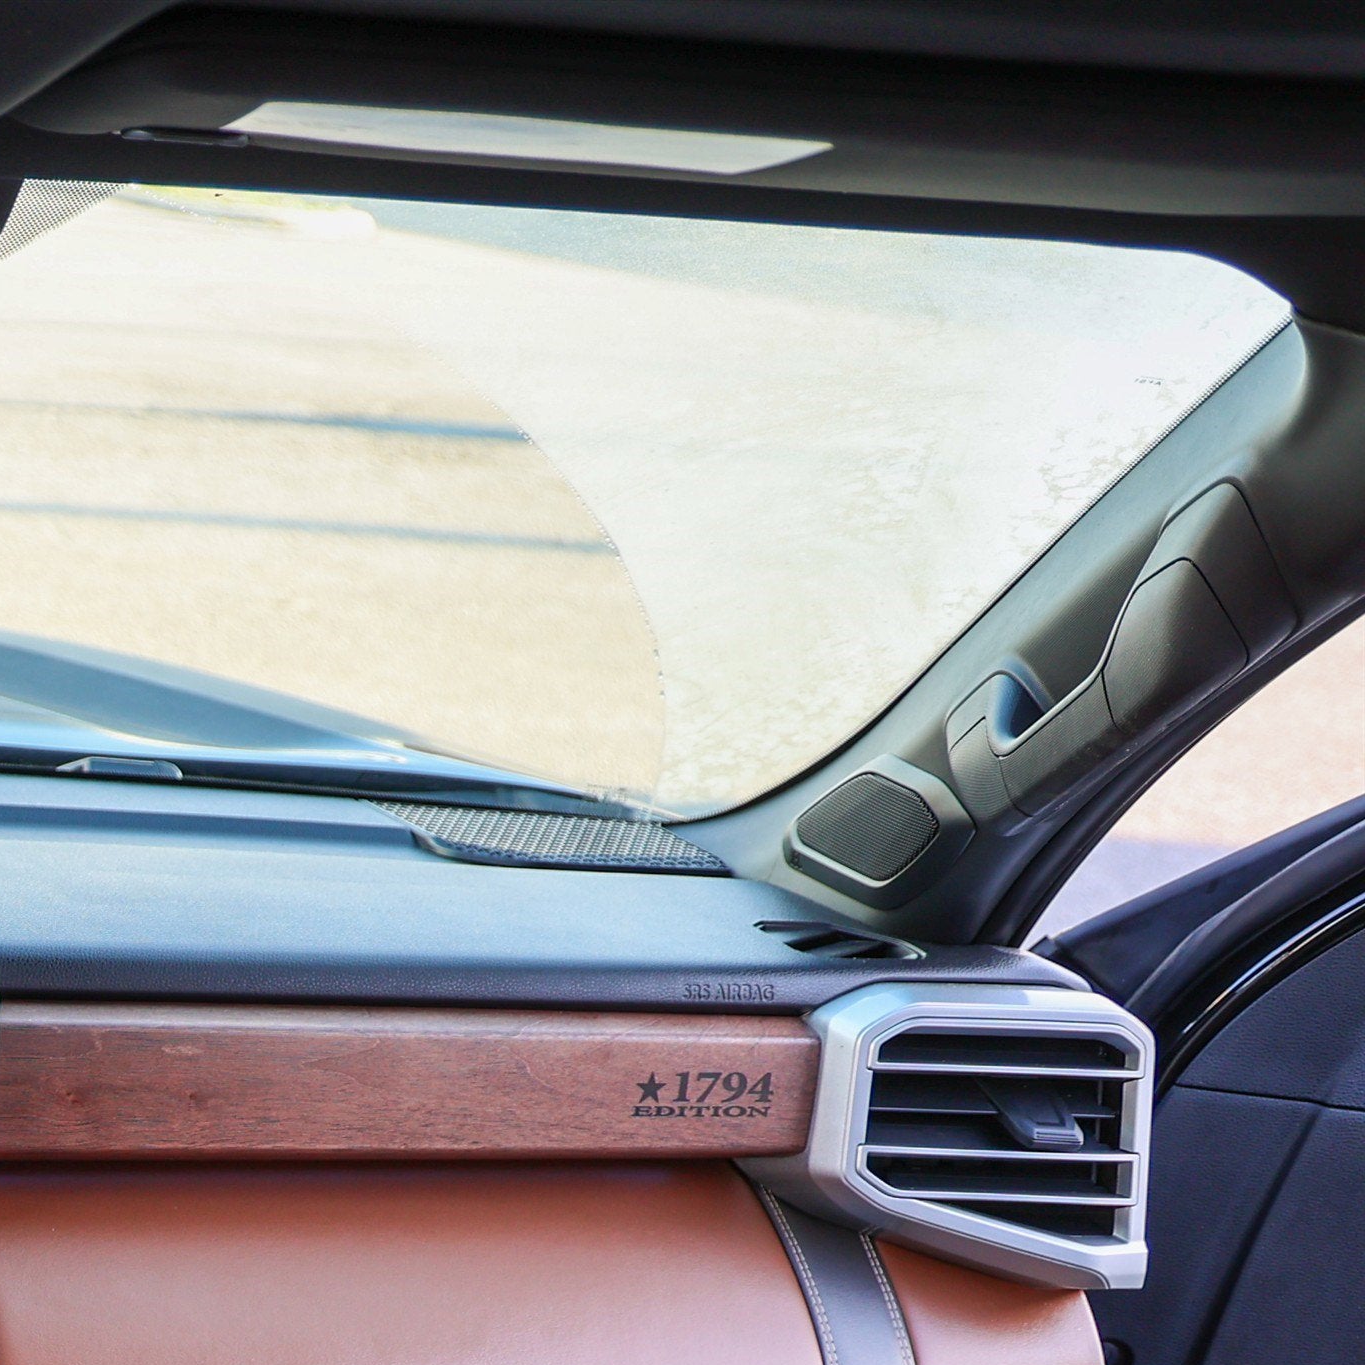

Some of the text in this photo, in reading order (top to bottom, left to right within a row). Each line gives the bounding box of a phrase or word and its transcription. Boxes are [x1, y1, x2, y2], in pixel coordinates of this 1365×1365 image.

[682, 983, 775, 1001] SRS AIRBAG
[674, 1071, 775, 1103] 1794
[631, 1105, 771, 1118] EDITION
